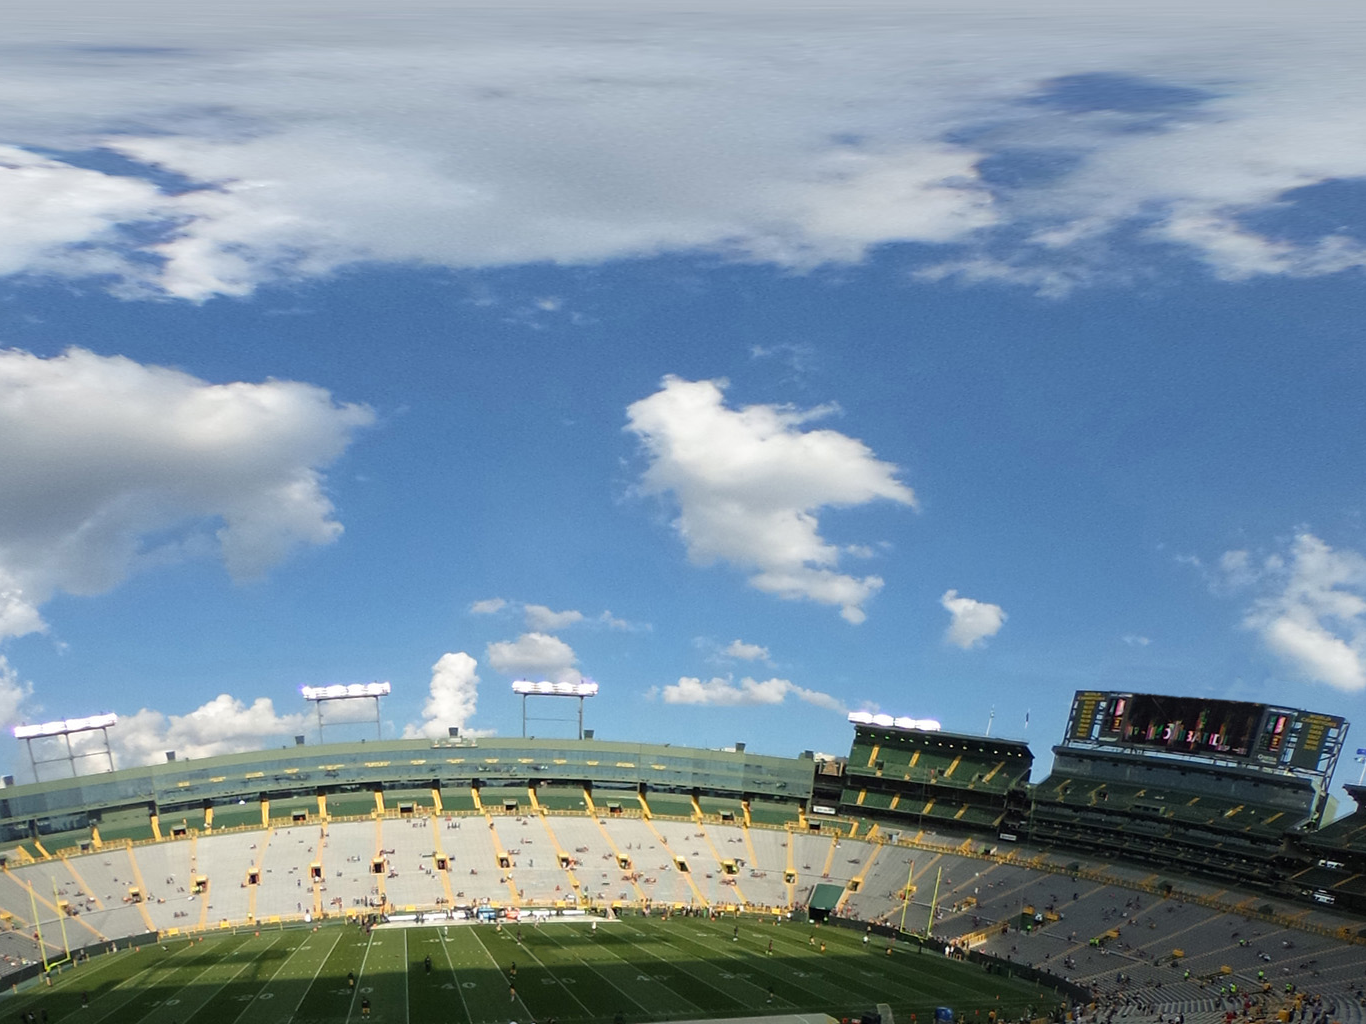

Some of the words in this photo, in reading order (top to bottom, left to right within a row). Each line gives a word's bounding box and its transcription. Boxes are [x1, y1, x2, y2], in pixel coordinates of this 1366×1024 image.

[540, 977, 576, 985] 50
[338, 986, 374, 995] 30
[441, 982, 476, 991] 40
[234, 992, 274, 1001] 20
